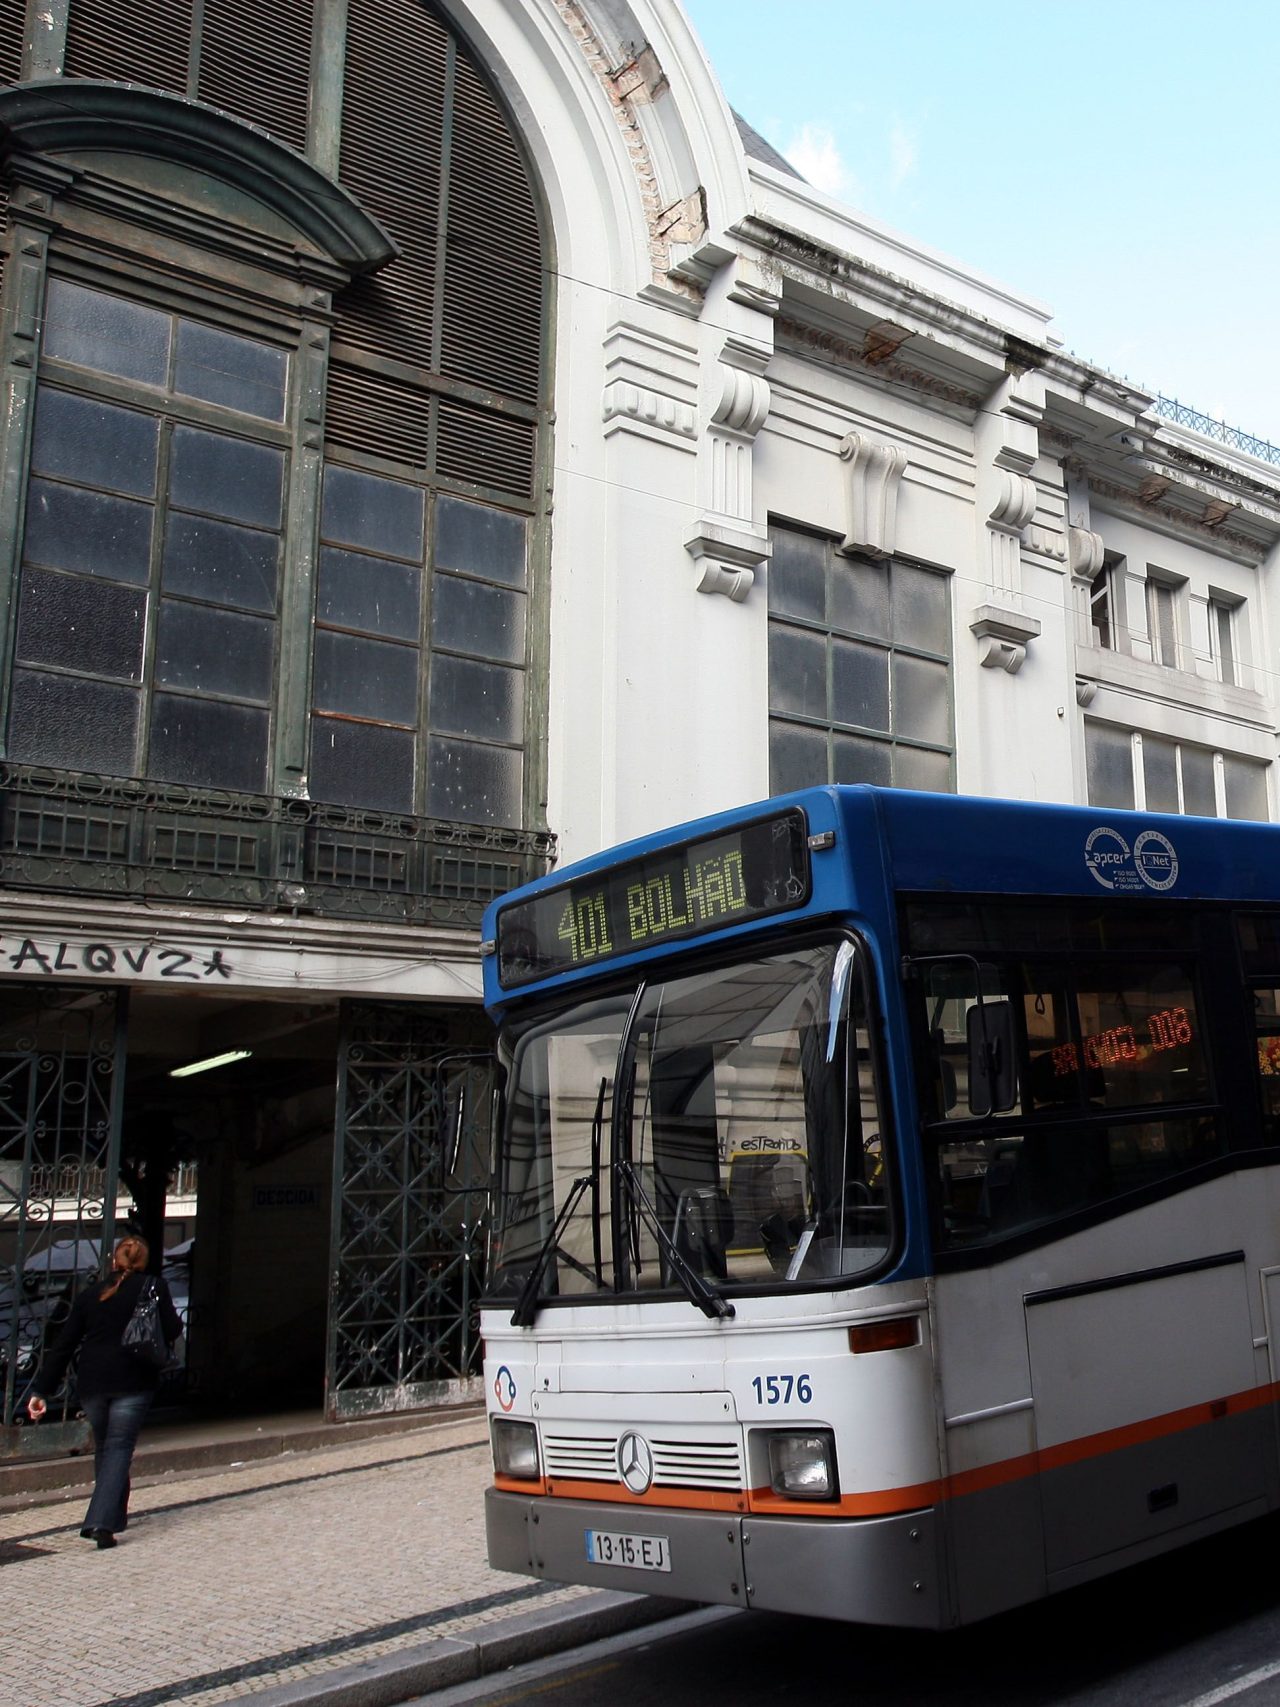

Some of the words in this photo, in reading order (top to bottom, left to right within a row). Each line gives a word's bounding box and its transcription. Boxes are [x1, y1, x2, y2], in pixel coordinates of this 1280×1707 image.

[1093, 852, 1124, 867] apcer
[558, 892, 612, 962] 401
[627, 850, 746, 940] BOLHÃO
[752, 1374, 813, 1405] 1576
